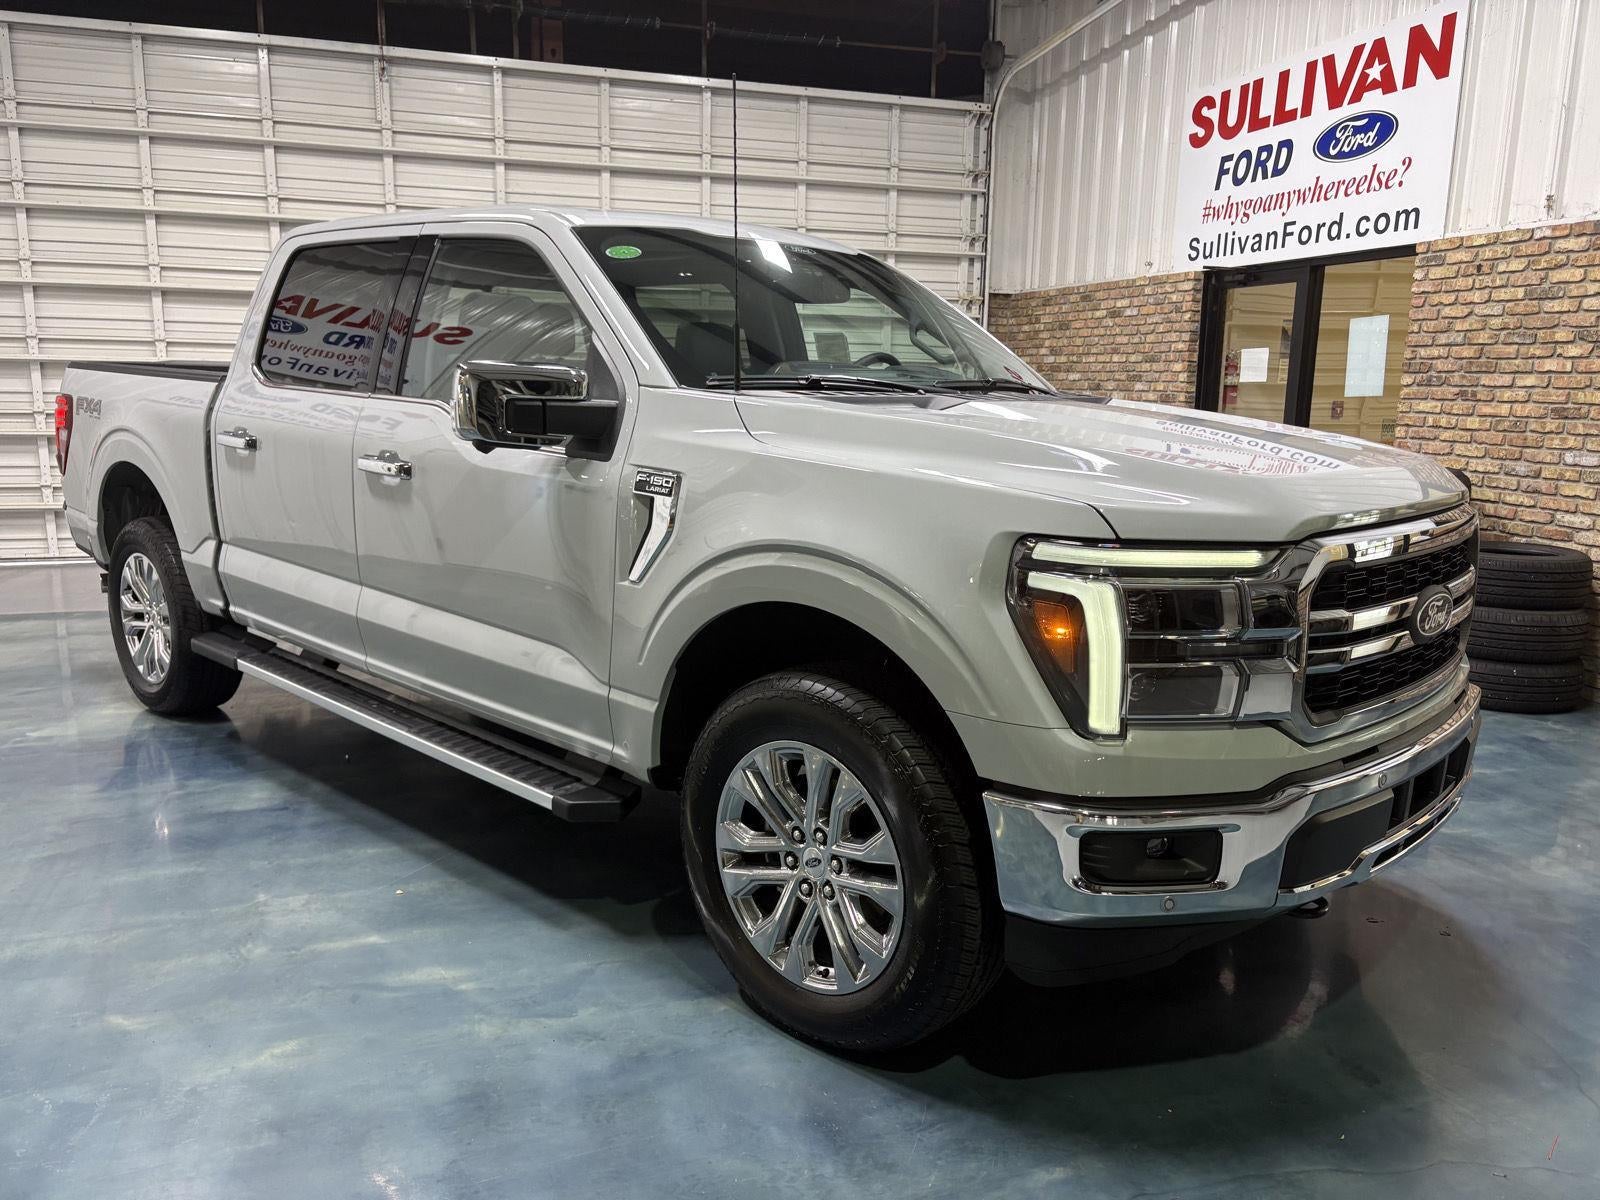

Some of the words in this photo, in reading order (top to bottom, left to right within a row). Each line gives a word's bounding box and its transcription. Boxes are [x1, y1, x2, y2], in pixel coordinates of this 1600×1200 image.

[1188, 11, 1458, 149] SULLIVAN
[1329, 118, 1381, 156] Ford
[1214, 138, 1294, 191] FORD
[1202, 156, 1413, 225] #whygoanywhereelse?
[1187, 205, 1421, 262] SullivanFord.com
[636, 473, 675, 488] F-150
[645, 485, 670, 494] LARIAT
[1424, 599, 1448, 631] Ford
